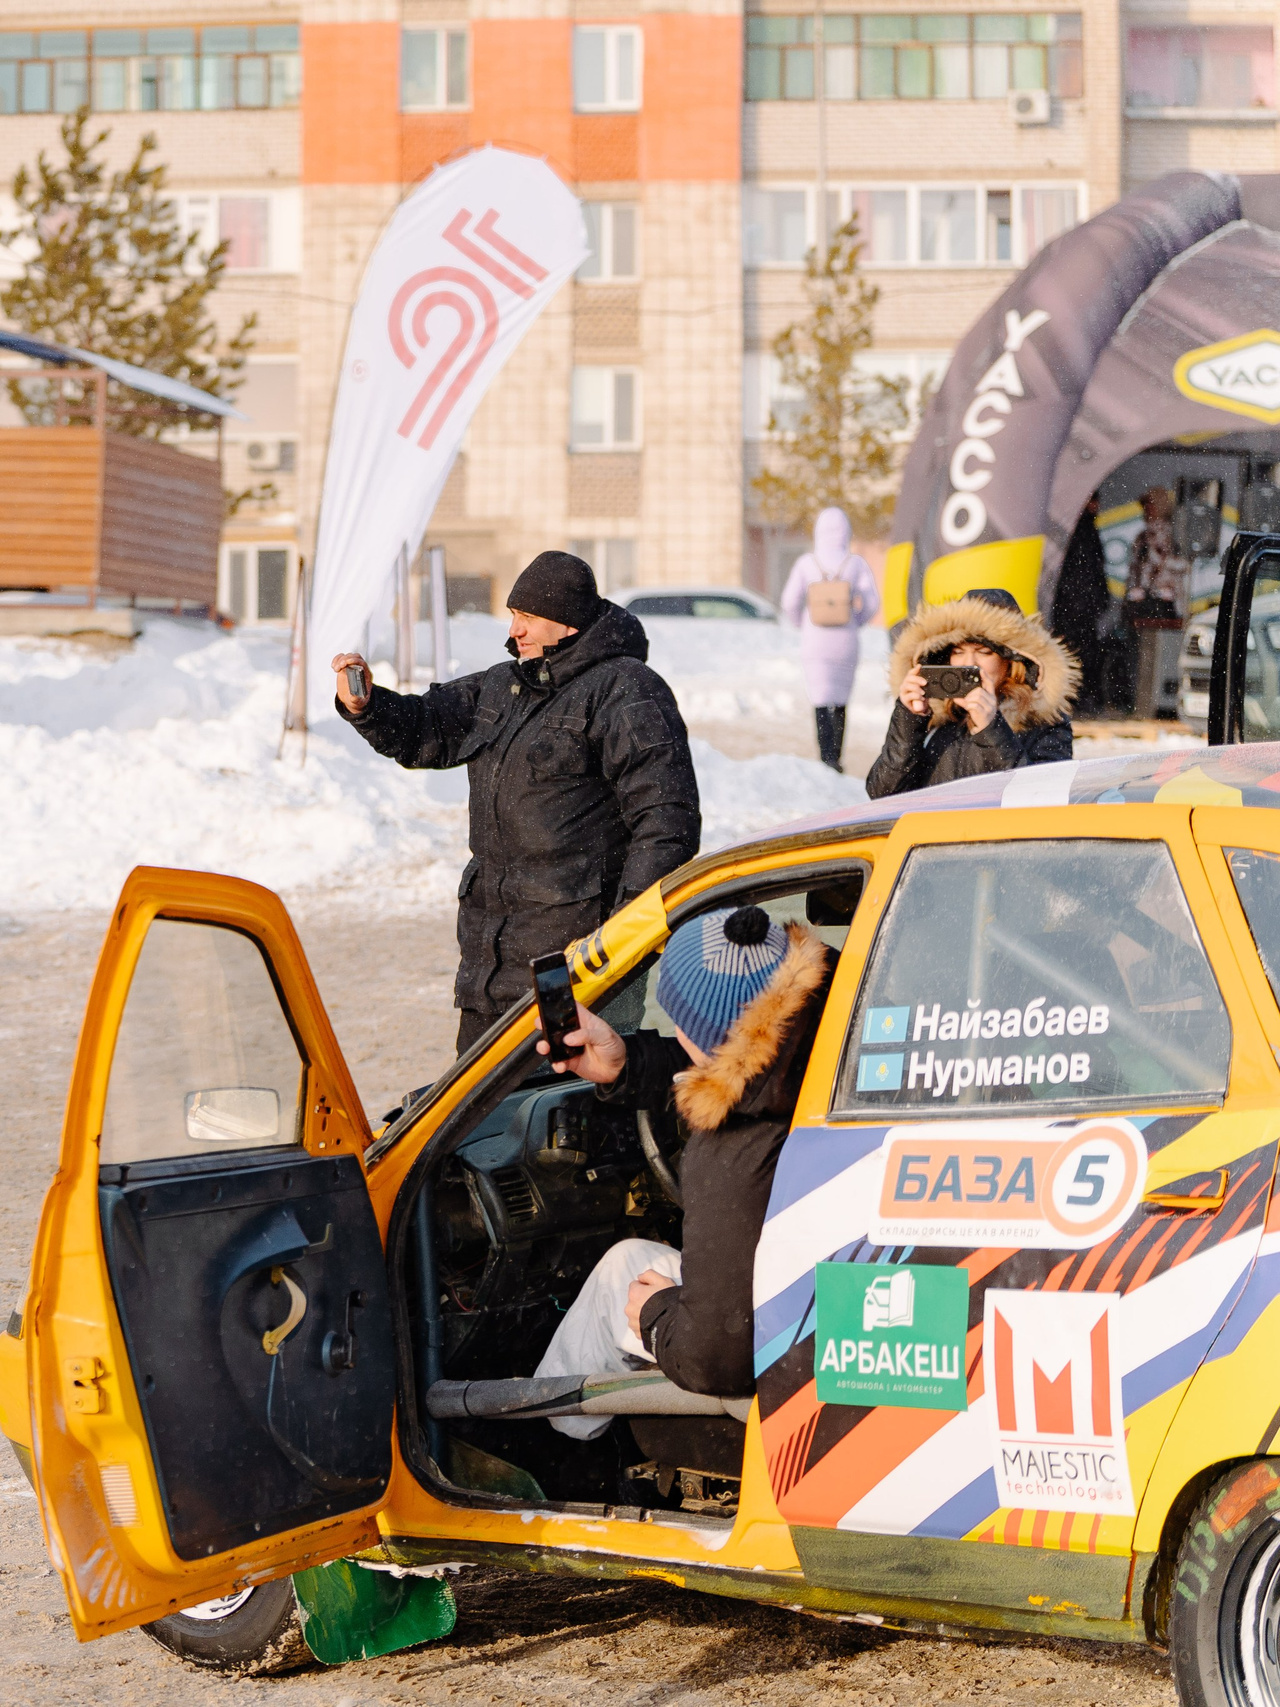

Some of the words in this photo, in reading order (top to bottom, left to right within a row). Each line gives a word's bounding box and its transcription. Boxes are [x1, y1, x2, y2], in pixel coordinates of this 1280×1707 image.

[941, 309, 1052, 547] YACCO
[912, 996, 1110, 1042] Найзабаев
[906, 1050, 1091, 1098] Нурманов
[893, 1154, 1036, 1203] БАЗА
[1066, 1154, 1110, 1207] 5
[998, 1227, 1041, 1238] АРЕНДУ
[819, 1338, 959, 1380] АРБАКЕШ
[836, 1380, 884, 1391] АВТОШКОЛА
[1002, 1448, 1117, 1483] MAJESTIC
[1006, 1480, 1123, 1501] technologes
